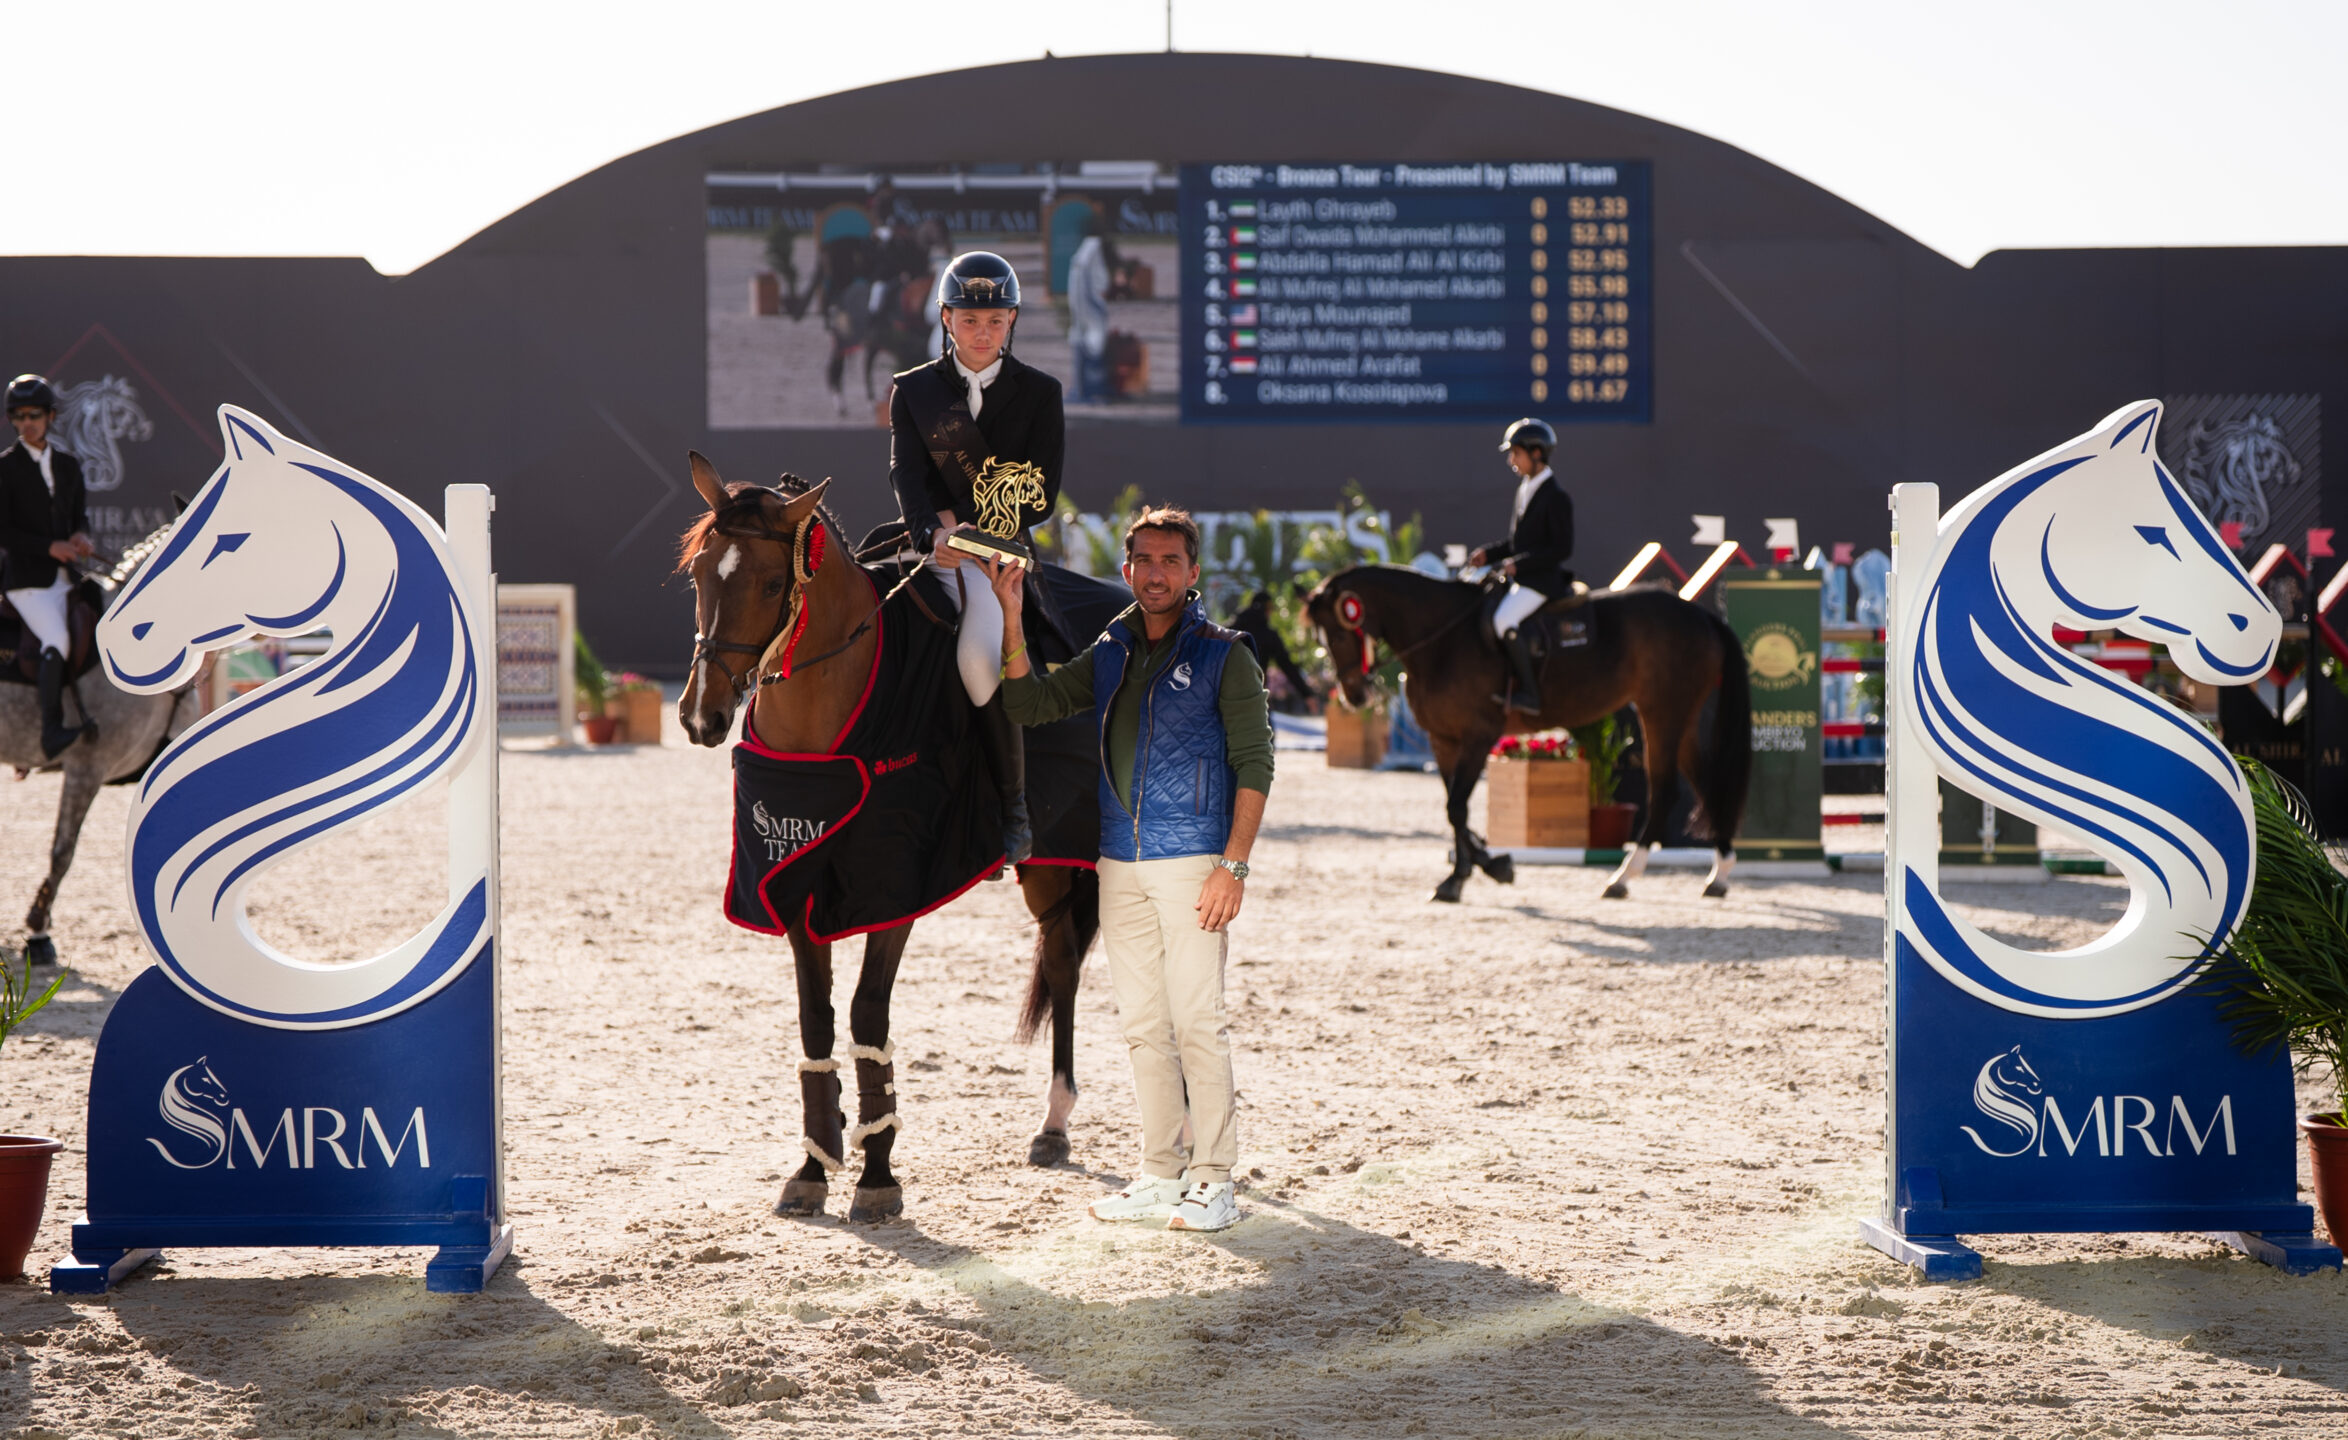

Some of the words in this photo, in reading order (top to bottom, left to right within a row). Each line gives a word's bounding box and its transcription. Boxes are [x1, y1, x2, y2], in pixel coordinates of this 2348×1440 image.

[1277, 166, 1339, 187] Bronze
[1340, 165, 1380, 187] Tour
[1395, 164, 1482, 187] Presented
[1484, 164, 1506, 190] by
[1509, 164, 1566, 186] SMRM
[1568, 164, 1617, 186] Team
[1206, 200, 1227, 221] 1.
[1258, 200, 1312, 223] Layth
[1315, 199, 1397, 224] Ghrayeb
[1531, 197, 1547, 219] 0
[1569, 197, 1628, 219] 52.33
[1205, 225, 1228, 247] 2.
[1531, 223, 1547, 245] 0
[1572, 223, 1628, 245] 52.91
[1205, 251, 1228, 273] 3.
[1258, 251, 1330, 273] Abdalla
[1333, 251, 1404, 273] Hamad
[1406, 250, 1433, 272] Ali
[1436, 250, 1457, 272] Al
[1460, 250, 1505, 272] Kirbi
[1531, 250, 1547, 271] 0
[1569, 250, 1628, 271] 52.95
[1205, 277, 1228, 299] 4.
[1366, 277, 1447, 299] Mohamed
[1531, 275, 1547, 298] 0
[1569, 275, 1628, 298] 55.98
[1205, 303, 1228, 326] 5.
[1259, 303, 1312, 330] Talya
[1315, 303, 1411, 330] Mounajed
[1531, 301, 1547, 324] 0
[1569, 301, 1628, 324] 57.10
[1205, 328, 1228, 350] 6.
[1531, 327, 1547, 350] 0
[1569, 327, 1628, 350] 58.43
[1205, 355, 1228, 378] 7.
[1258, 355, 1286, 378] Ali
[1288, 355, 1358, 378] Ahmed
[1360, 355, 1421, 378] Arafat
[1531, 353, 1547, 376] 0
[1569, 353, 1628, 376] 59.49
[1205, 381, 1228, 404] 8.
[1258, 381, 1332, 404] Oksana
[1334, 381, 1447, 408] Kosolapova
[1531, 379, 1547, 402] 0
[1569, 379, 1628, 402] 61.67
[1751, 710, 1817, 727] ANDERS
[1752, 726, 1804, 738] MBRYO
[1752, 738, 1807, 751] UCTION
[888, 752, 918, 772] bucas
[753, 801, 826, 841] SMRM
[764, 839, 811, 862] TEA
[145, 1055, 430, 1169] SMRM
[1960, 1044, 2237, 1157] SMRM
